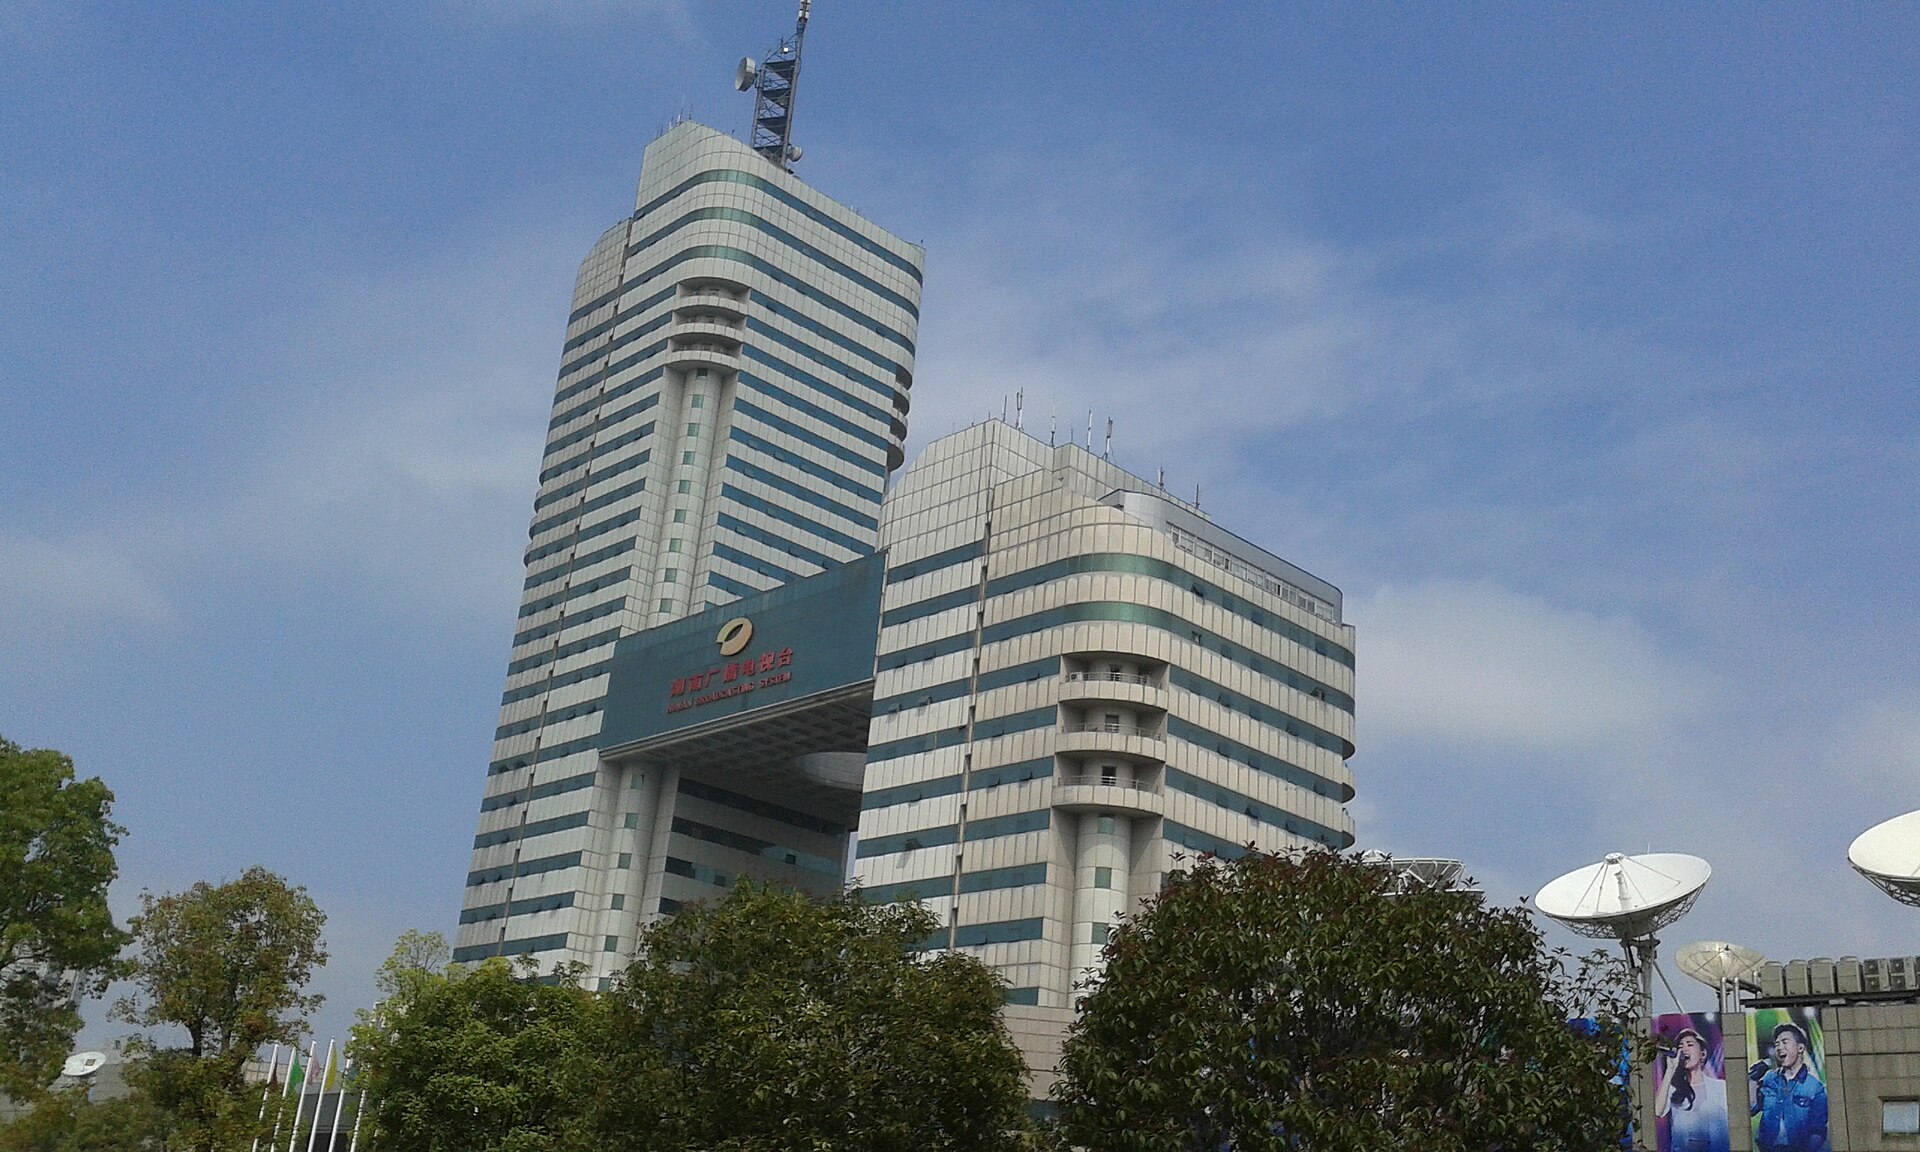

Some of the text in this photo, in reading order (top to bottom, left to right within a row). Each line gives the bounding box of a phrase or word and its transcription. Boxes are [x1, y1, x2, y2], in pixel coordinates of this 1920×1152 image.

[671, 648, 792, 696] 湖南广播电视台
[760, 672, 791, 687] SYSTEM
